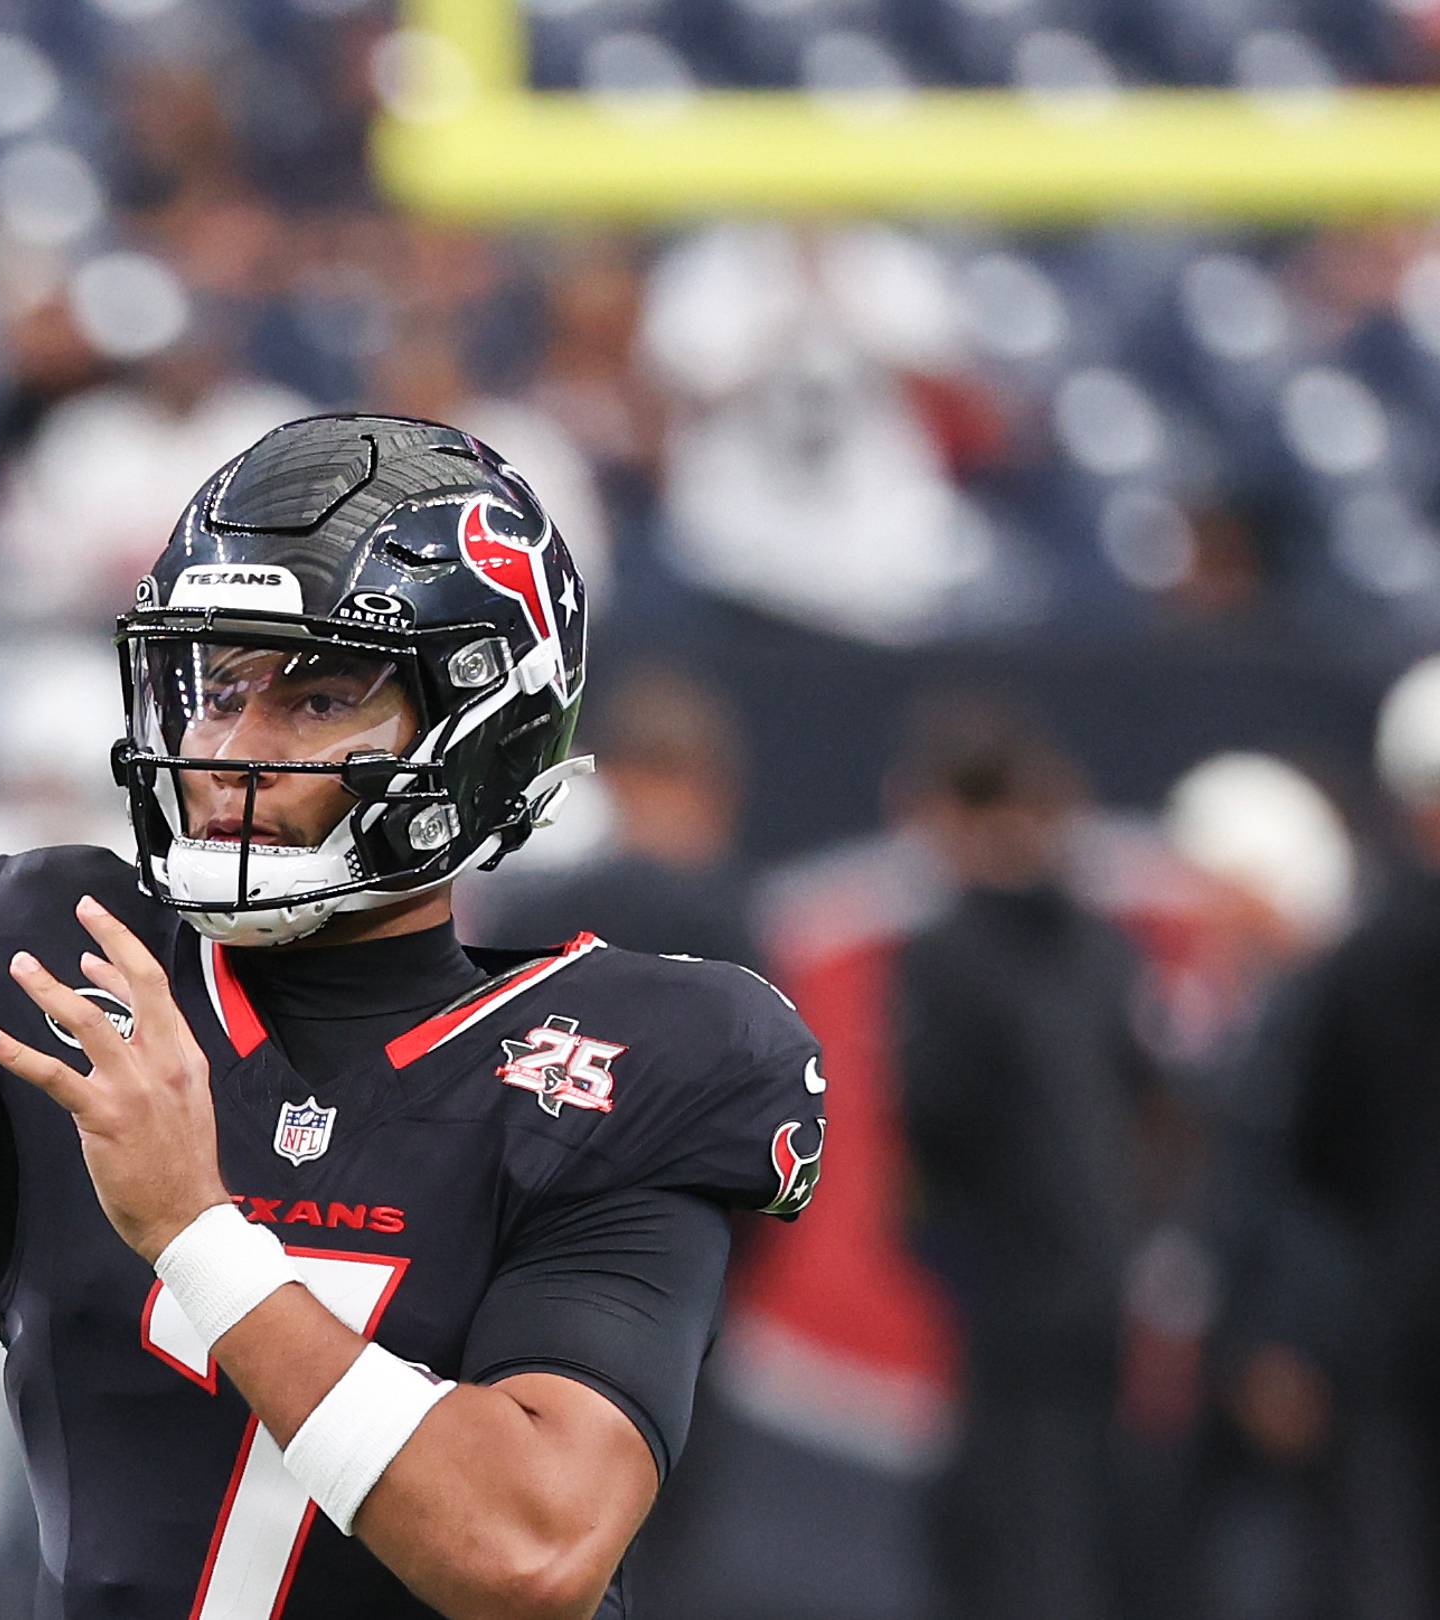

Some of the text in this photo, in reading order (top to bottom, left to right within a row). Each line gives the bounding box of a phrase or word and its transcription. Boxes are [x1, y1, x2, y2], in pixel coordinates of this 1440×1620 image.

[185, 573, 282, 586] TEXANS
[339, 607, 412, 629] OAKLEY
[504, 1026, 629, 1105] 25
[283, 1127, 318, 1153] NFL
[141, 1244, 412, 1620] 7
